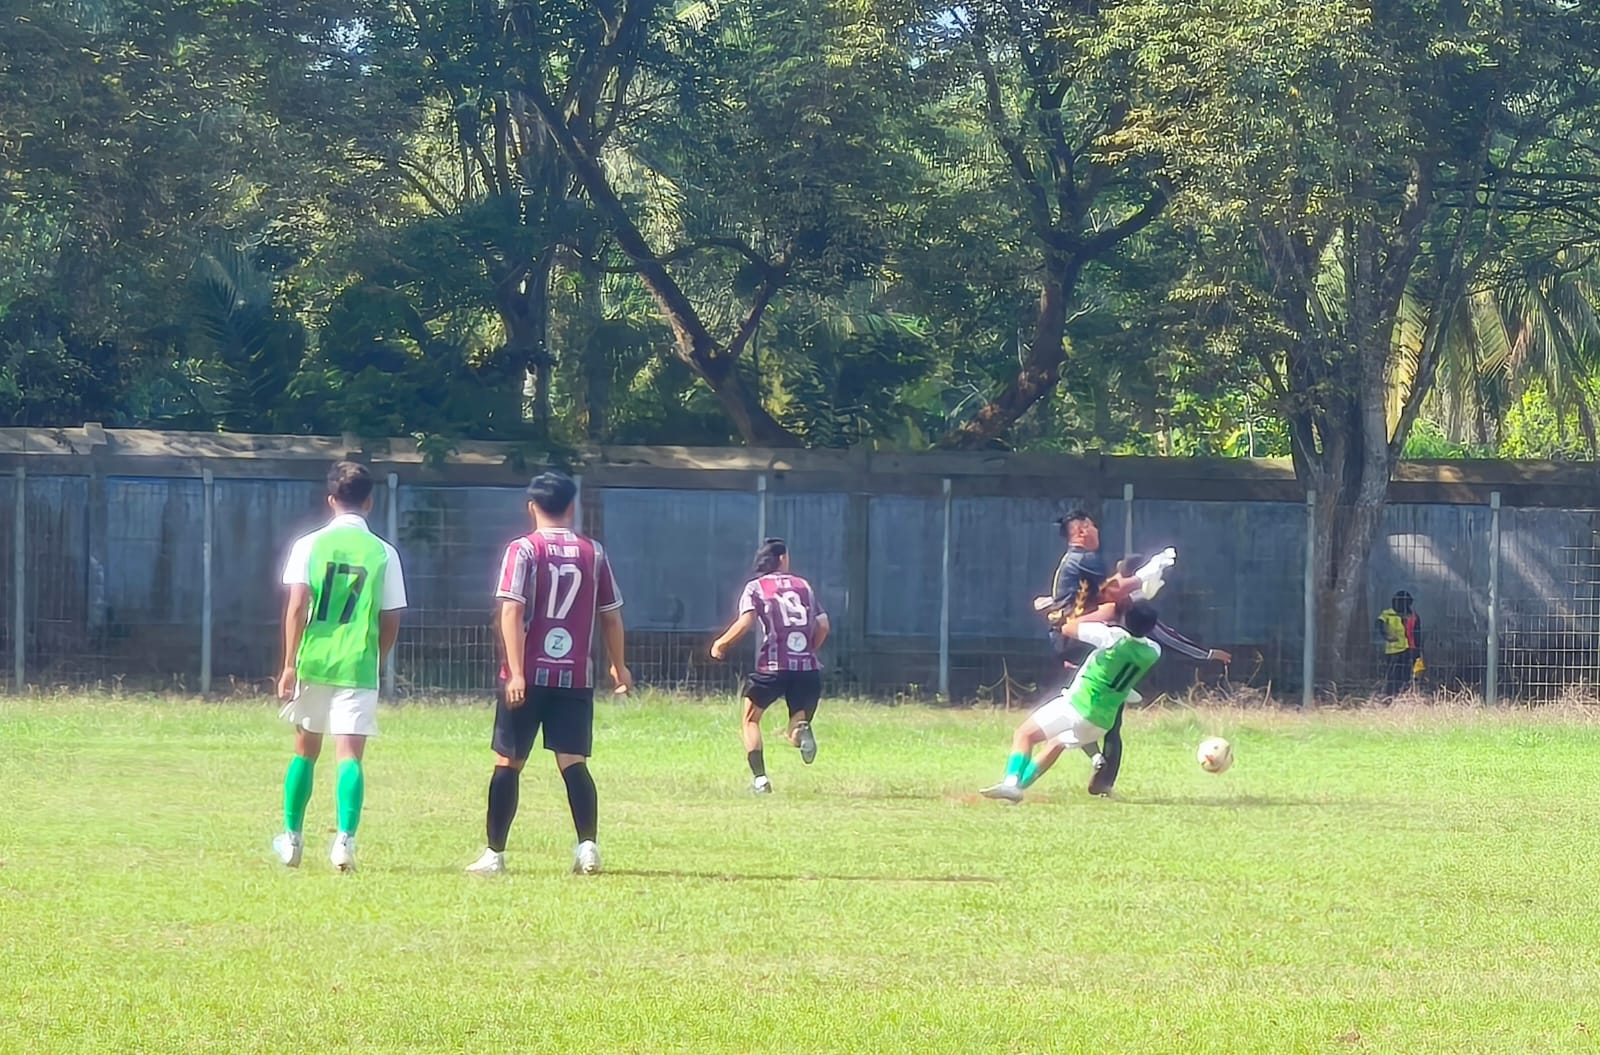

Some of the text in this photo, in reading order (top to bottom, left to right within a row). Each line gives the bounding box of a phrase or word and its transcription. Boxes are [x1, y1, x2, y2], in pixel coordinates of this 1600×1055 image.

[317, 562, 368, 624] 17
[547, 562, 582, 619] 17
[773, 591, 808, 627] 19
[1110, 661, 1141, 692] 11
